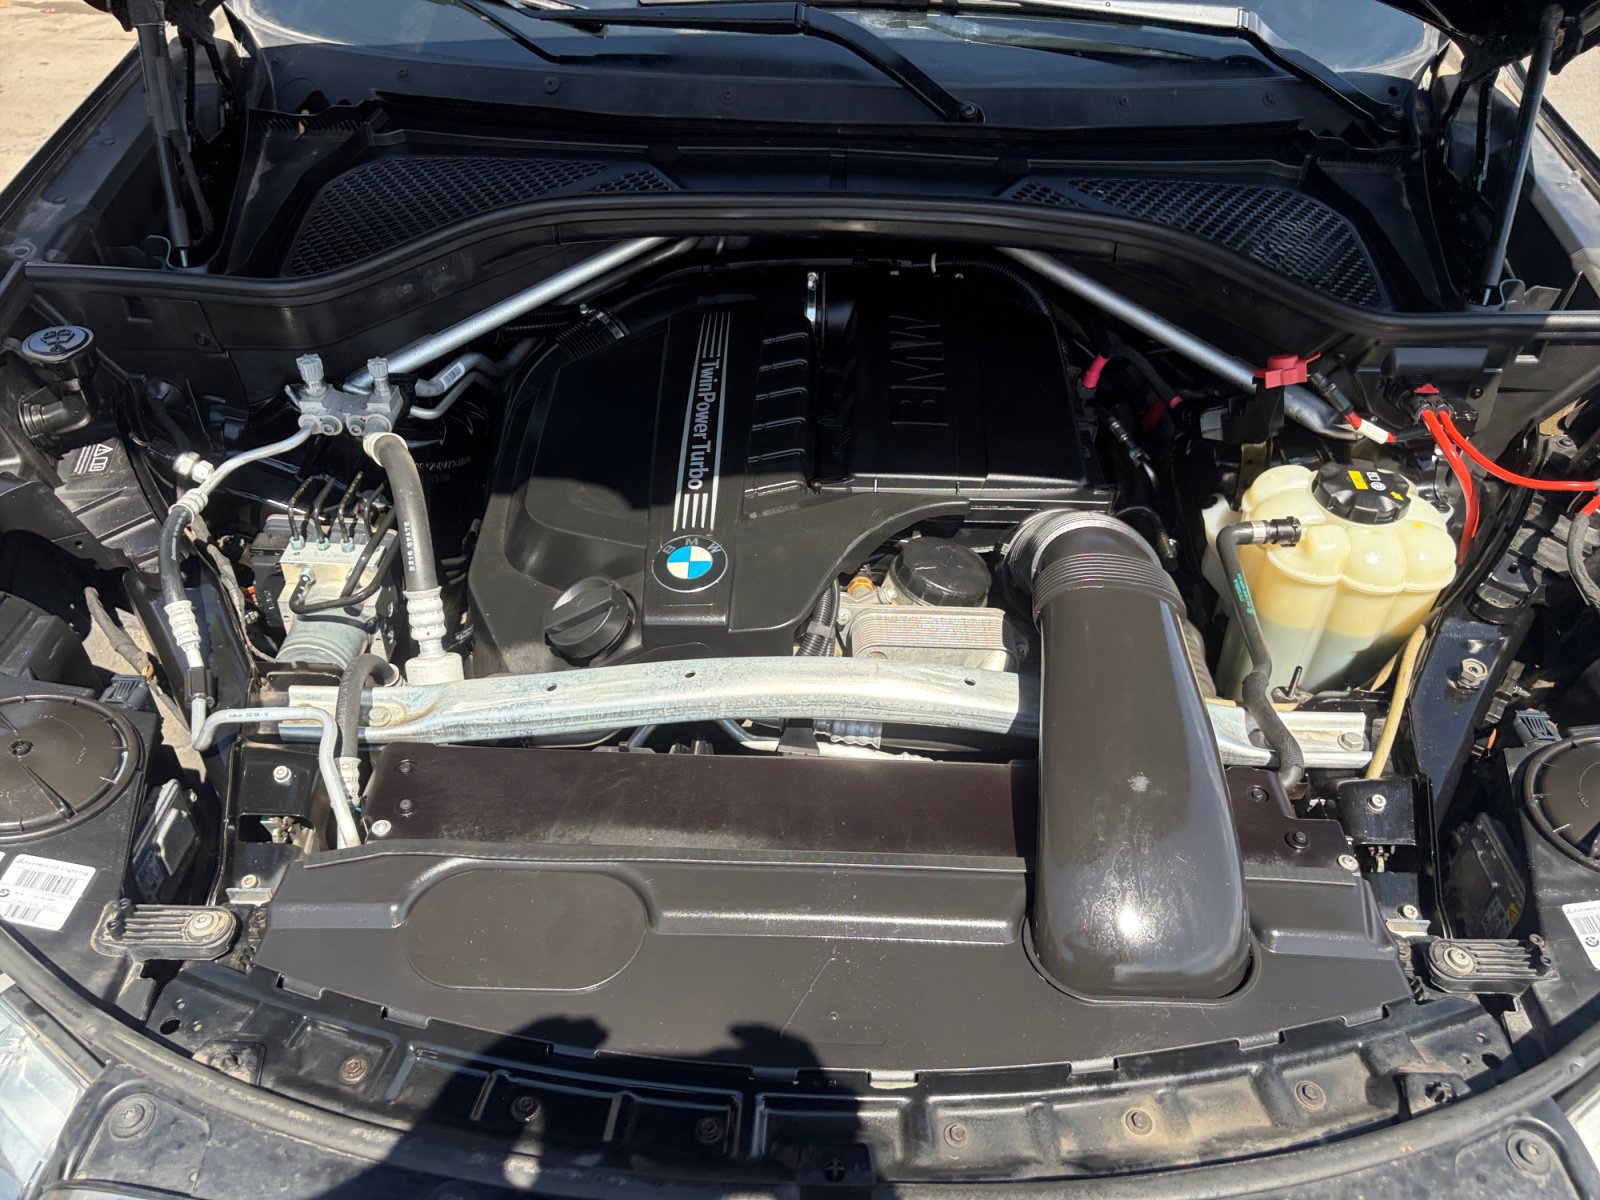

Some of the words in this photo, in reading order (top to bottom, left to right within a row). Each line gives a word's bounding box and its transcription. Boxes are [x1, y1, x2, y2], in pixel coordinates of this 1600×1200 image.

[693, 358, 720, 439] TwinPower
[889, 314, 949, 428] BMW
[687, 440, 712, 490] Turbo
[662, 538, 721, 555] BMW
